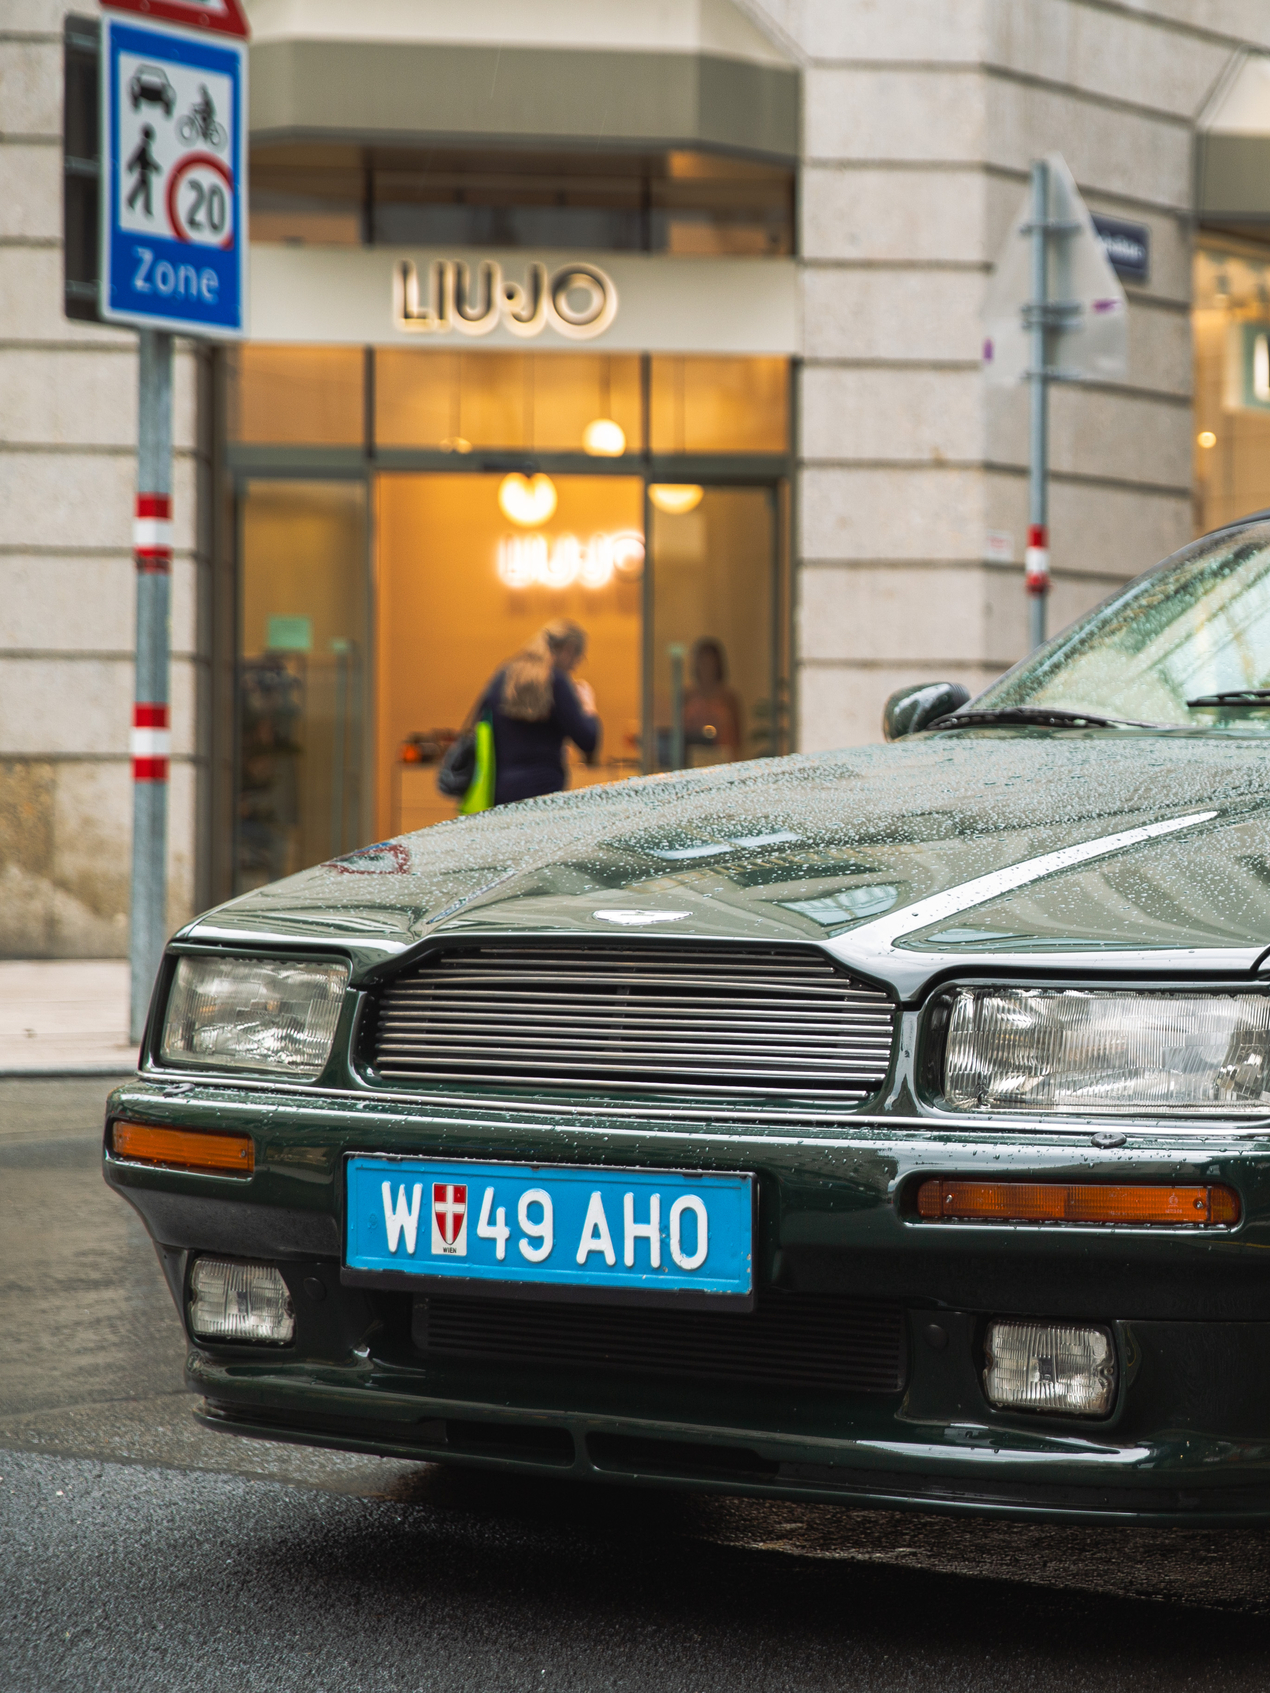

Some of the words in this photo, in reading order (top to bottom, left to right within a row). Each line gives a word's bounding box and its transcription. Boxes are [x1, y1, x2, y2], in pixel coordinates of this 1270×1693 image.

[186, 179, 226, 233] 20
[131, 246, 220, 304] Zone
[382, 1180, 423, 1255] W
[476, 1186, 554, 1264] 49
[575, 1190, 709, 1271] AHO
